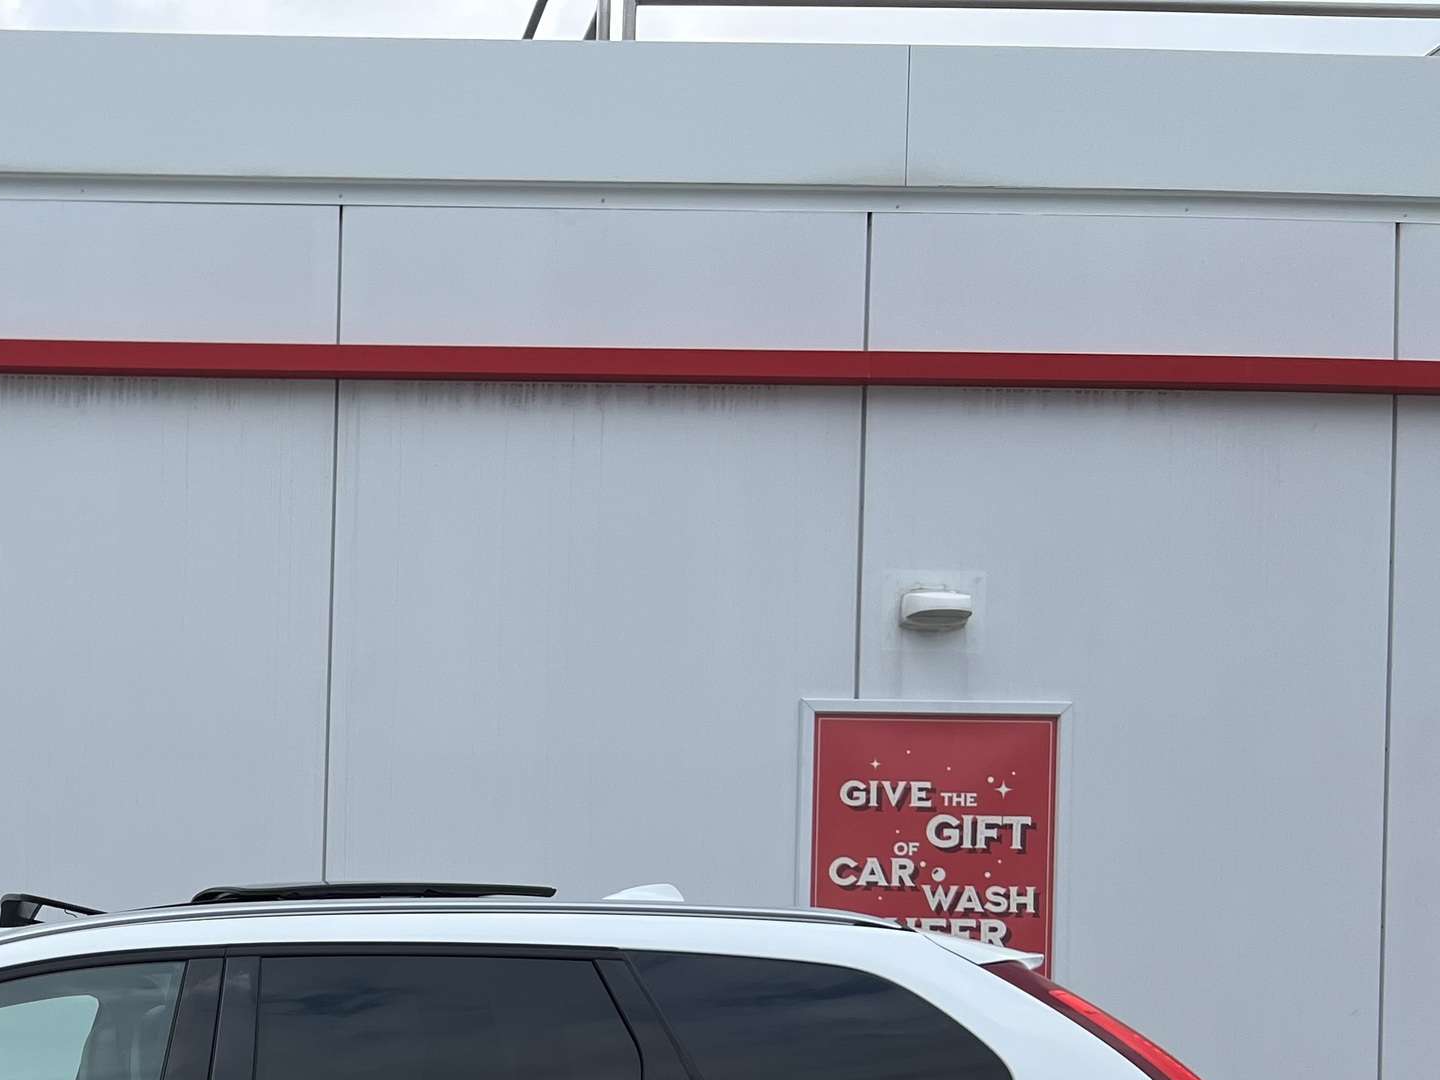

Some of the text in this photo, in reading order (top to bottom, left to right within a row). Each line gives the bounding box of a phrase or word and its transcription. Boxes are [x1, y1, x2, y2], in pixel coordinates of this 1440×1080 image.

[839, 779, 978, 810] GIVE THE
[926, 813, 1033, 851] GIFT
[893, 841, 920, 856] OF
[828, 856, 916, 888] CAR
[921, 884, 1037, 914] WASH
